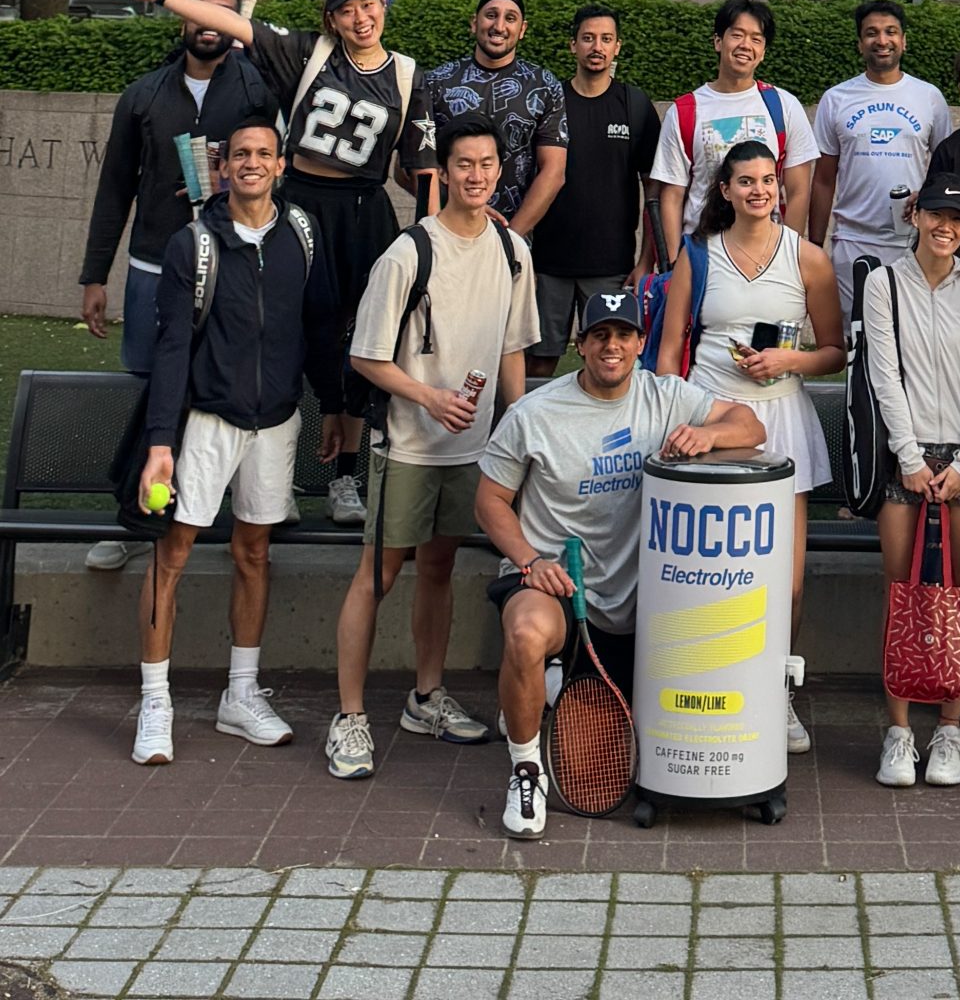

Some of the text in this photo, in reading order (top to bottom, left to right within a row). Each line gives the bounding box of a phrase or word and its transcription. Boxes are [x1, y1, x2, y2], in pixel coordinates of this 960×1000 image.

[299, 86, 389, 167] 23
[846, 102, 922, 132] SAP RUN CLUB
[871, 129, 895, 142] SAP
[194, 233, 211, 309] SOLINCO
[592, 450, 642, 476] NOCCO
[648, 496, 775, 558] NOCCO
[660, 563, 754, 591] Electrolyte
[674, 693, 727, 712] LEMON/LIME
[655, 746, 744, 763] CAFFEINE 200 mg
[667, 763, 731, 776] SUGAR FREE
